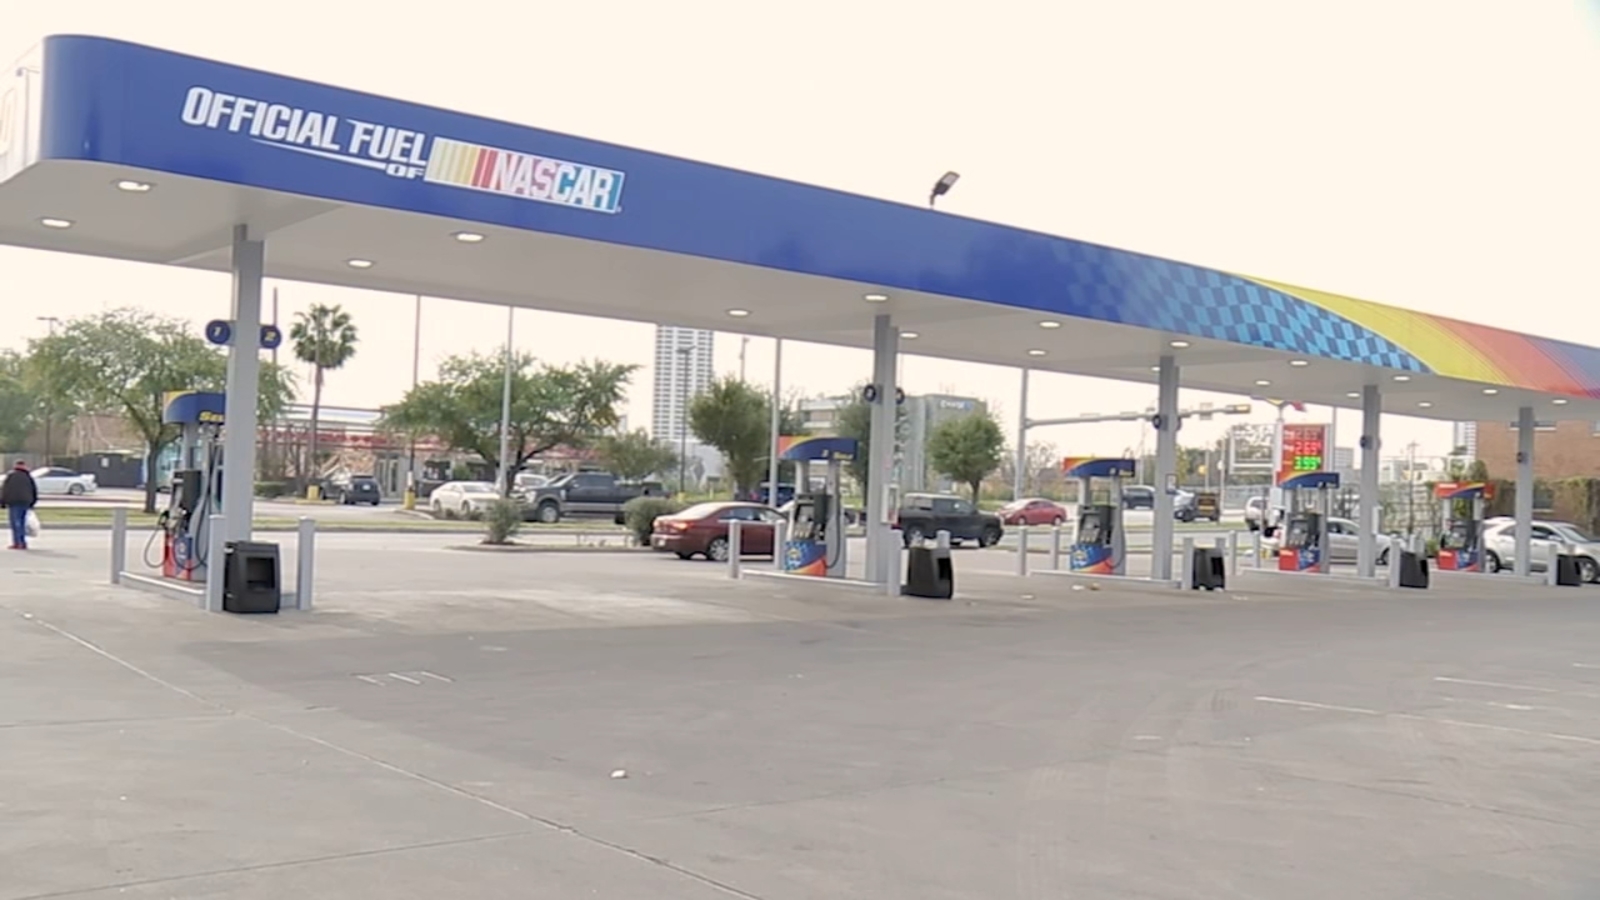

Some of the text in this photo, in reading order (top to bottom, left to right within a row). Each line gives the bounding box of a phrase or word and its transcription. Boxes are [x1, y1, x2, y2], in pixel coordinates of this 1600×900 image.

[181, 86, 427, 167] OFFICIAL FUEL
[386, 163, 425, 180] OF
[493, 152, 613, 210] NASCAR
